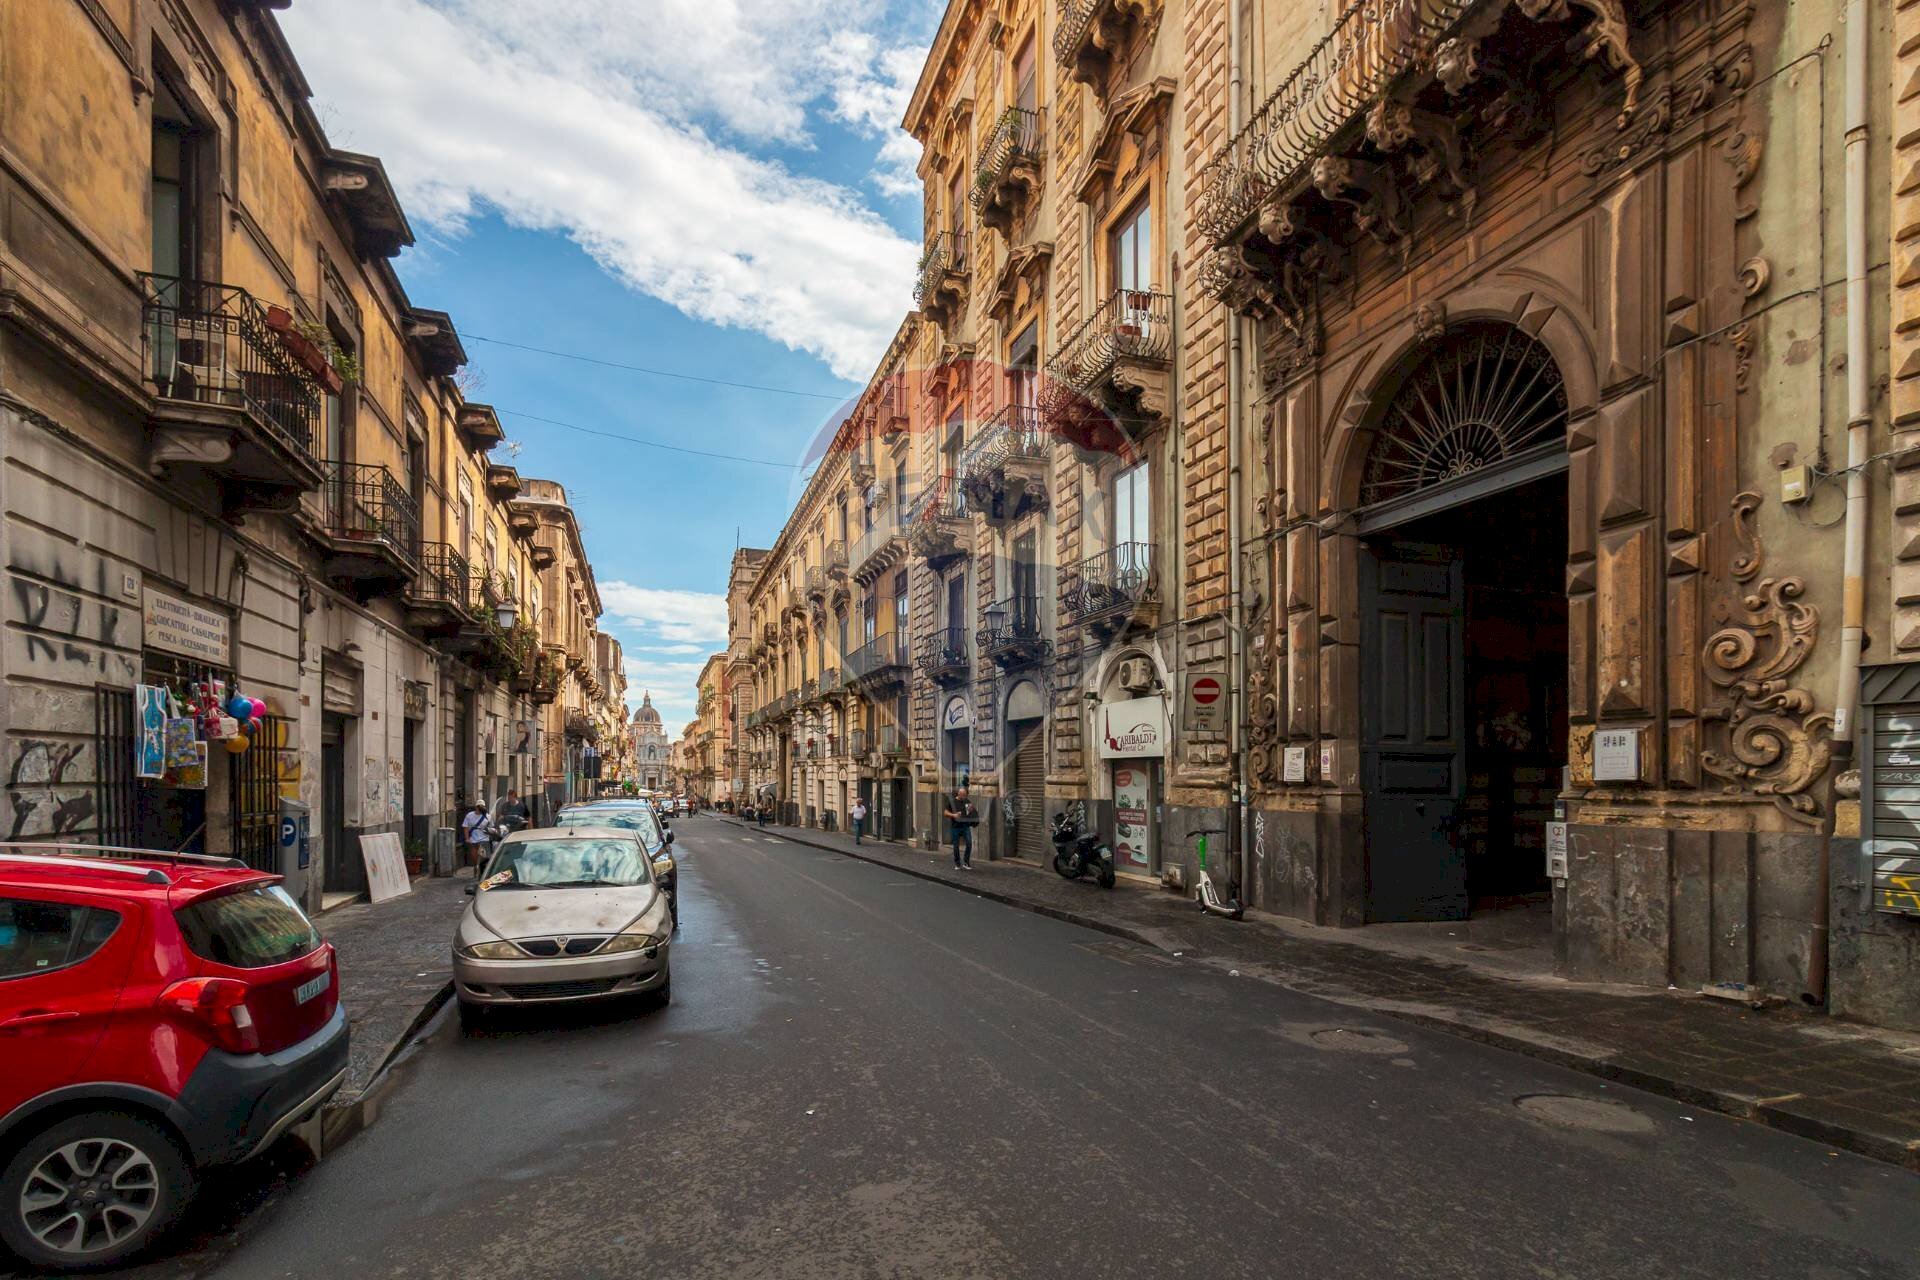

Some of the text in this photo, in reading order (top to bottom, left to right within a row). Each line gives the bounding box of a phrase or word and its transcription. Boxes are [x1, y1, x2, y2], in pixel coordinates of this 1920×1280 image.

[1117, 733, 1152, 751] GARIBALDI
[1123, 744, 1136, 752] Rental
[282, 825, 295, 840] P
